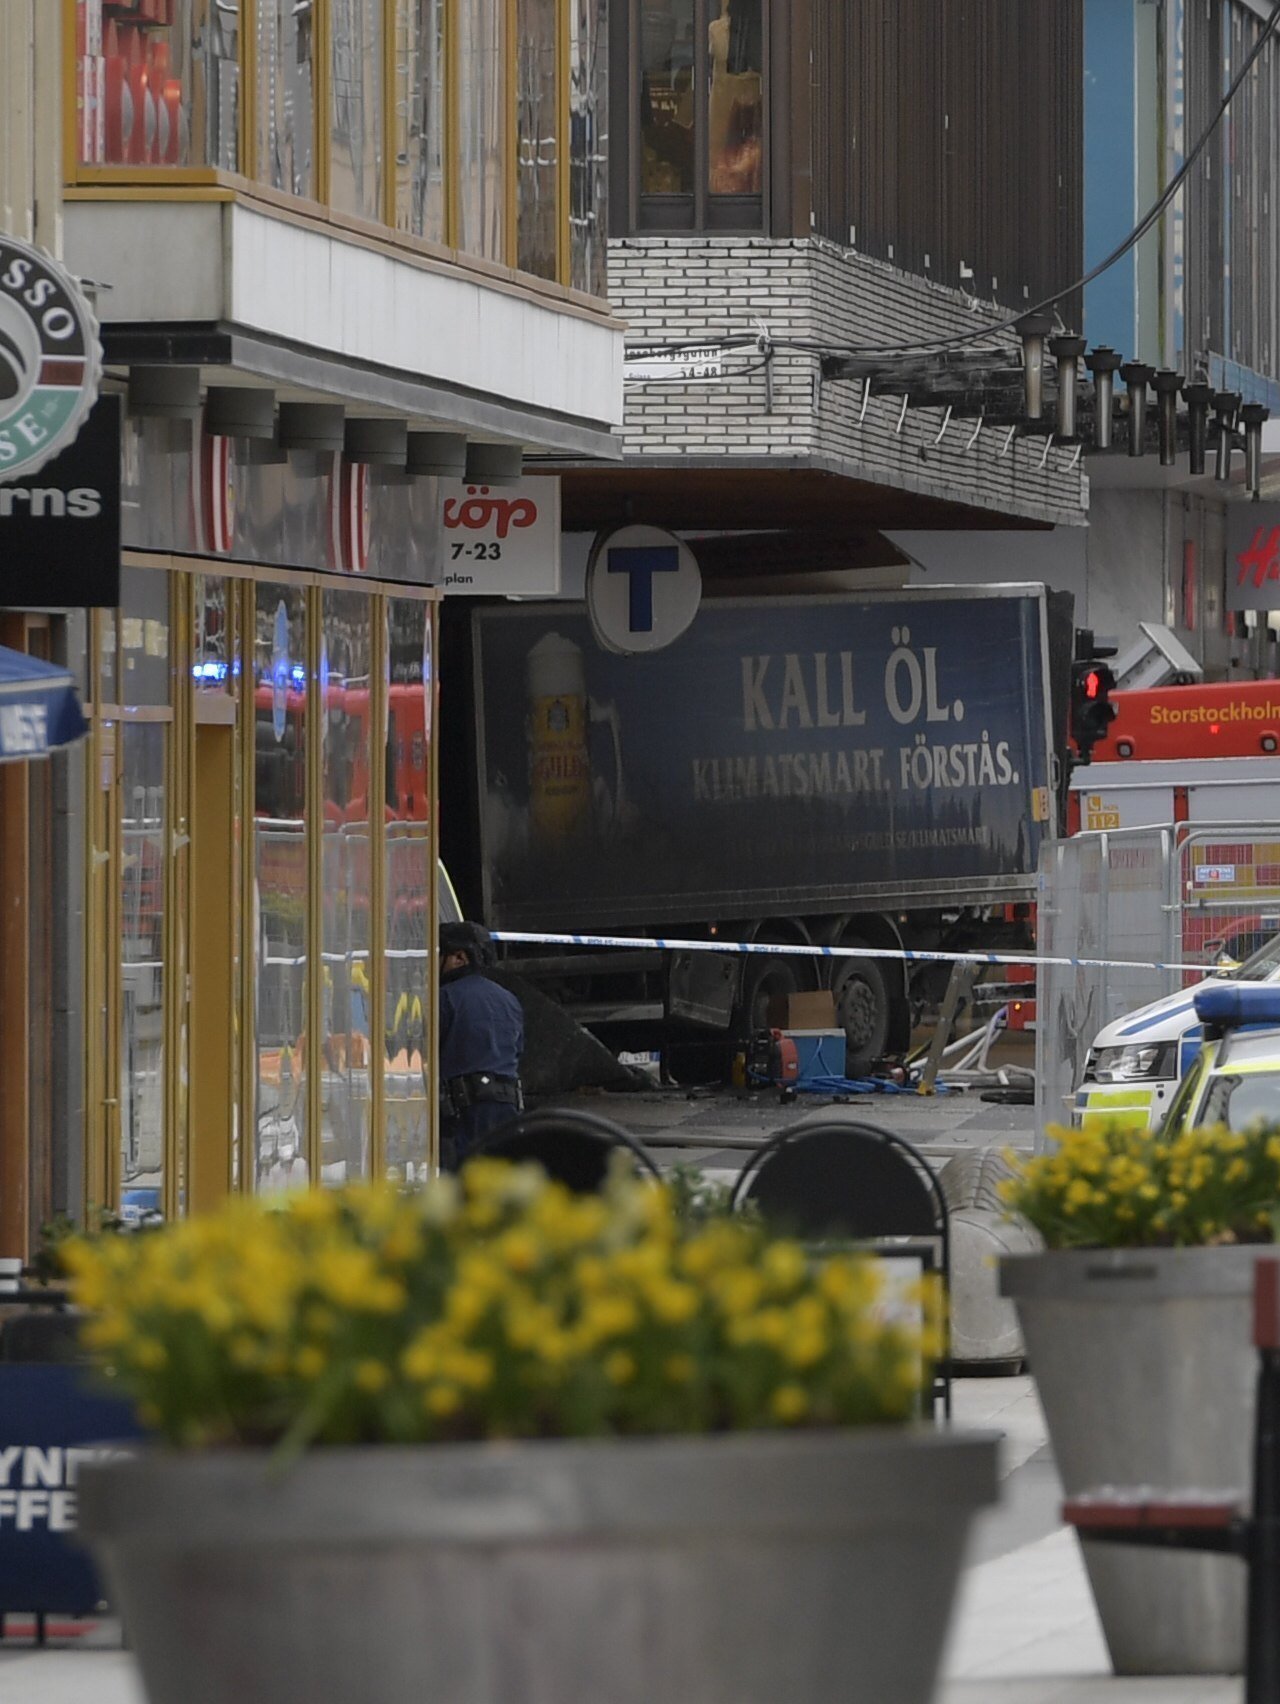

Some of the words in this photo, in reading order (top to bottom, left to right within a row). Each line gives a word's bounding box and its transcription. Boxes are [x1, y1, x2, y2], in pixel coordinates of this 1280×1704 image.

[0, 487, 101, 516] rns
[443, 573, 474, 585] plan
[608, 546, 679, 632] T
[740, 650, 866, 731] KALL
[884, 626, 964, 724] ÖL.
[693, 749, 891, 799] KLIMATSMART.
[901, 731, 1019, 790] FÖRSTÅS.
[1091, 814, 1117, 829] 112
